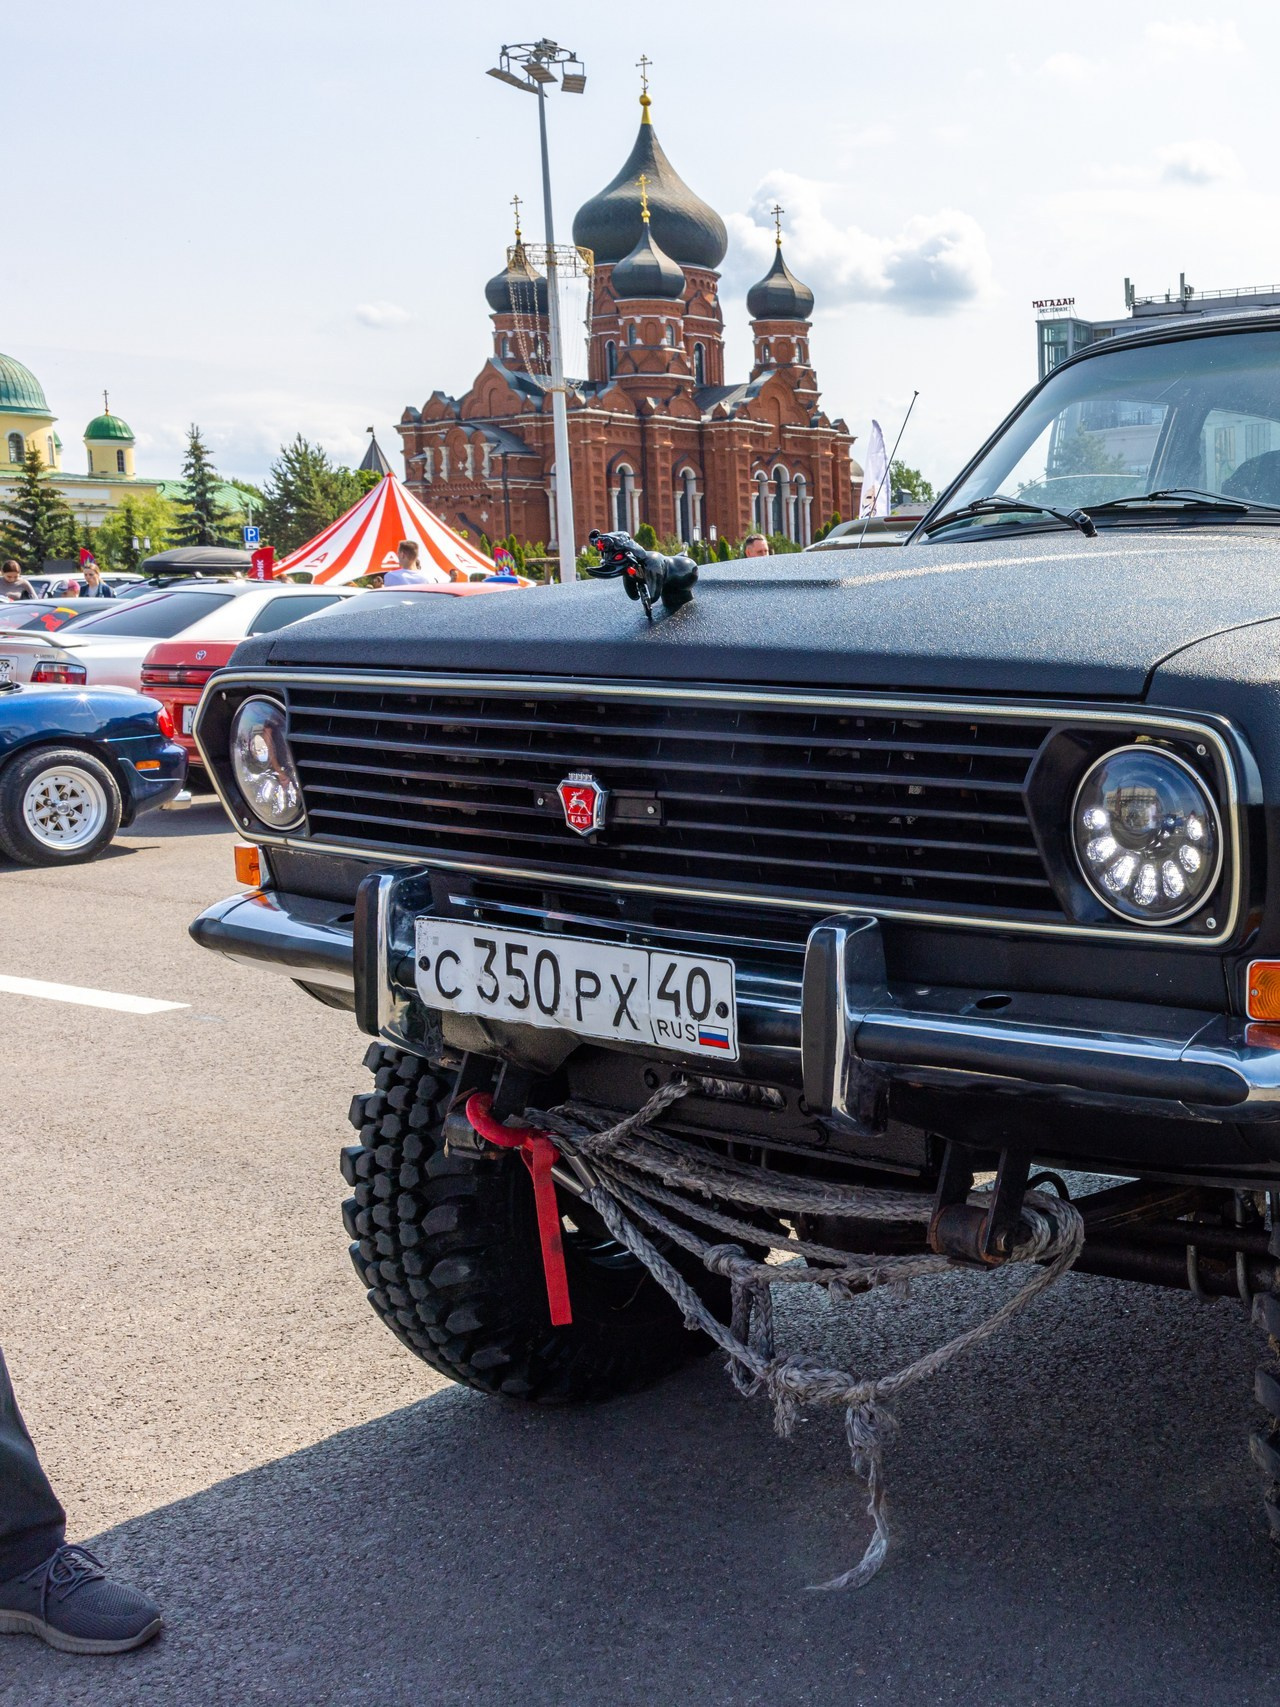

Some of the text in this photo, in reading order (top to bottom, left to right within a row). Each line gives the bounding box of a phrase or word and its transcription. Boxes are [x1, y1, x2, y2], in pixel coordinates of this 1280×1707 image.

[1032, 297, 1075, 308] МАГАДАН
[571, 815, 588, 824] ГАЗ
[473, 937, 561, 1016] 350
[575, 969, 641, 1031] РХ
[656, 962, 712, 1023] 40
[657, 1019, 697, 1043] RUS
